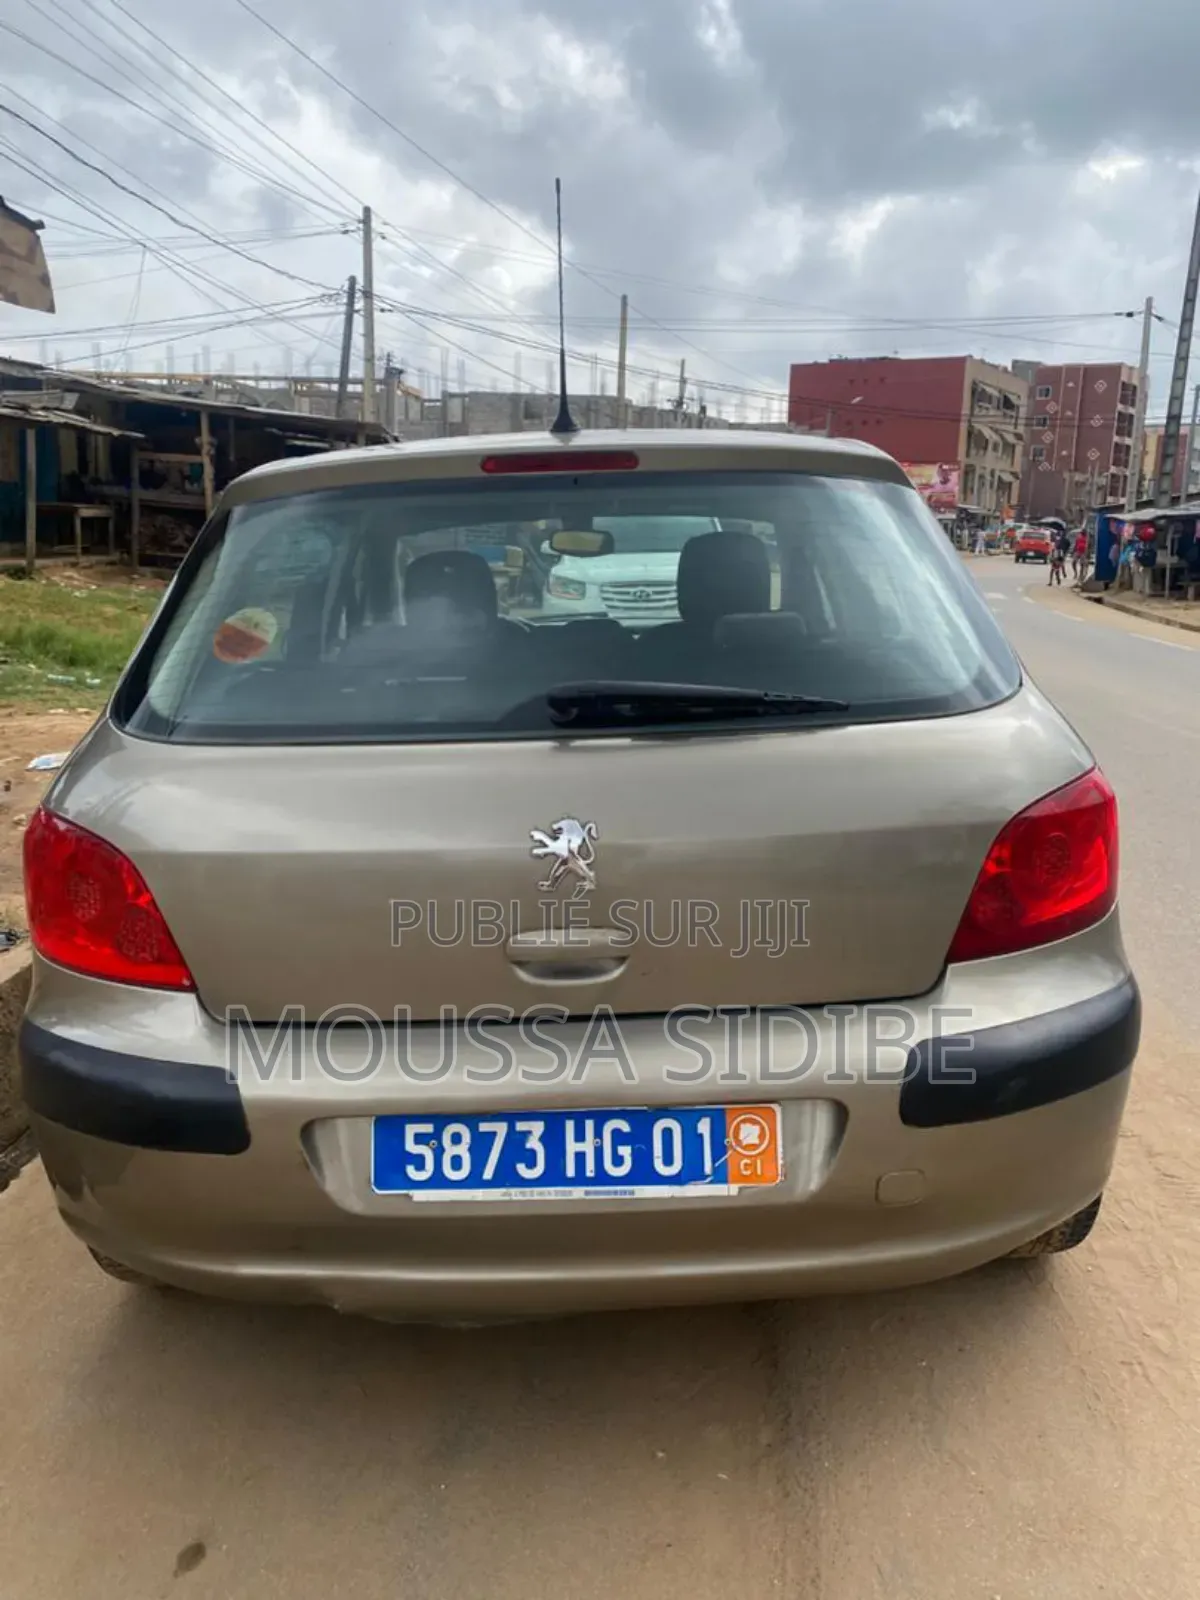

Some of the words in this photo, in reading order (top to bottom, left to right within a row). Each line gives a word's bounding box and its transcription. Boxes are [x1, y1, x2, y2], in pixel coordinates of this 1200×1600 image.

[404, 1120, 547, 1182] 5873
[565, 1119, 632, 1178] HG
[652, 1117, 713, 1177] 01
[739, 1158, 762, 1176] CI
